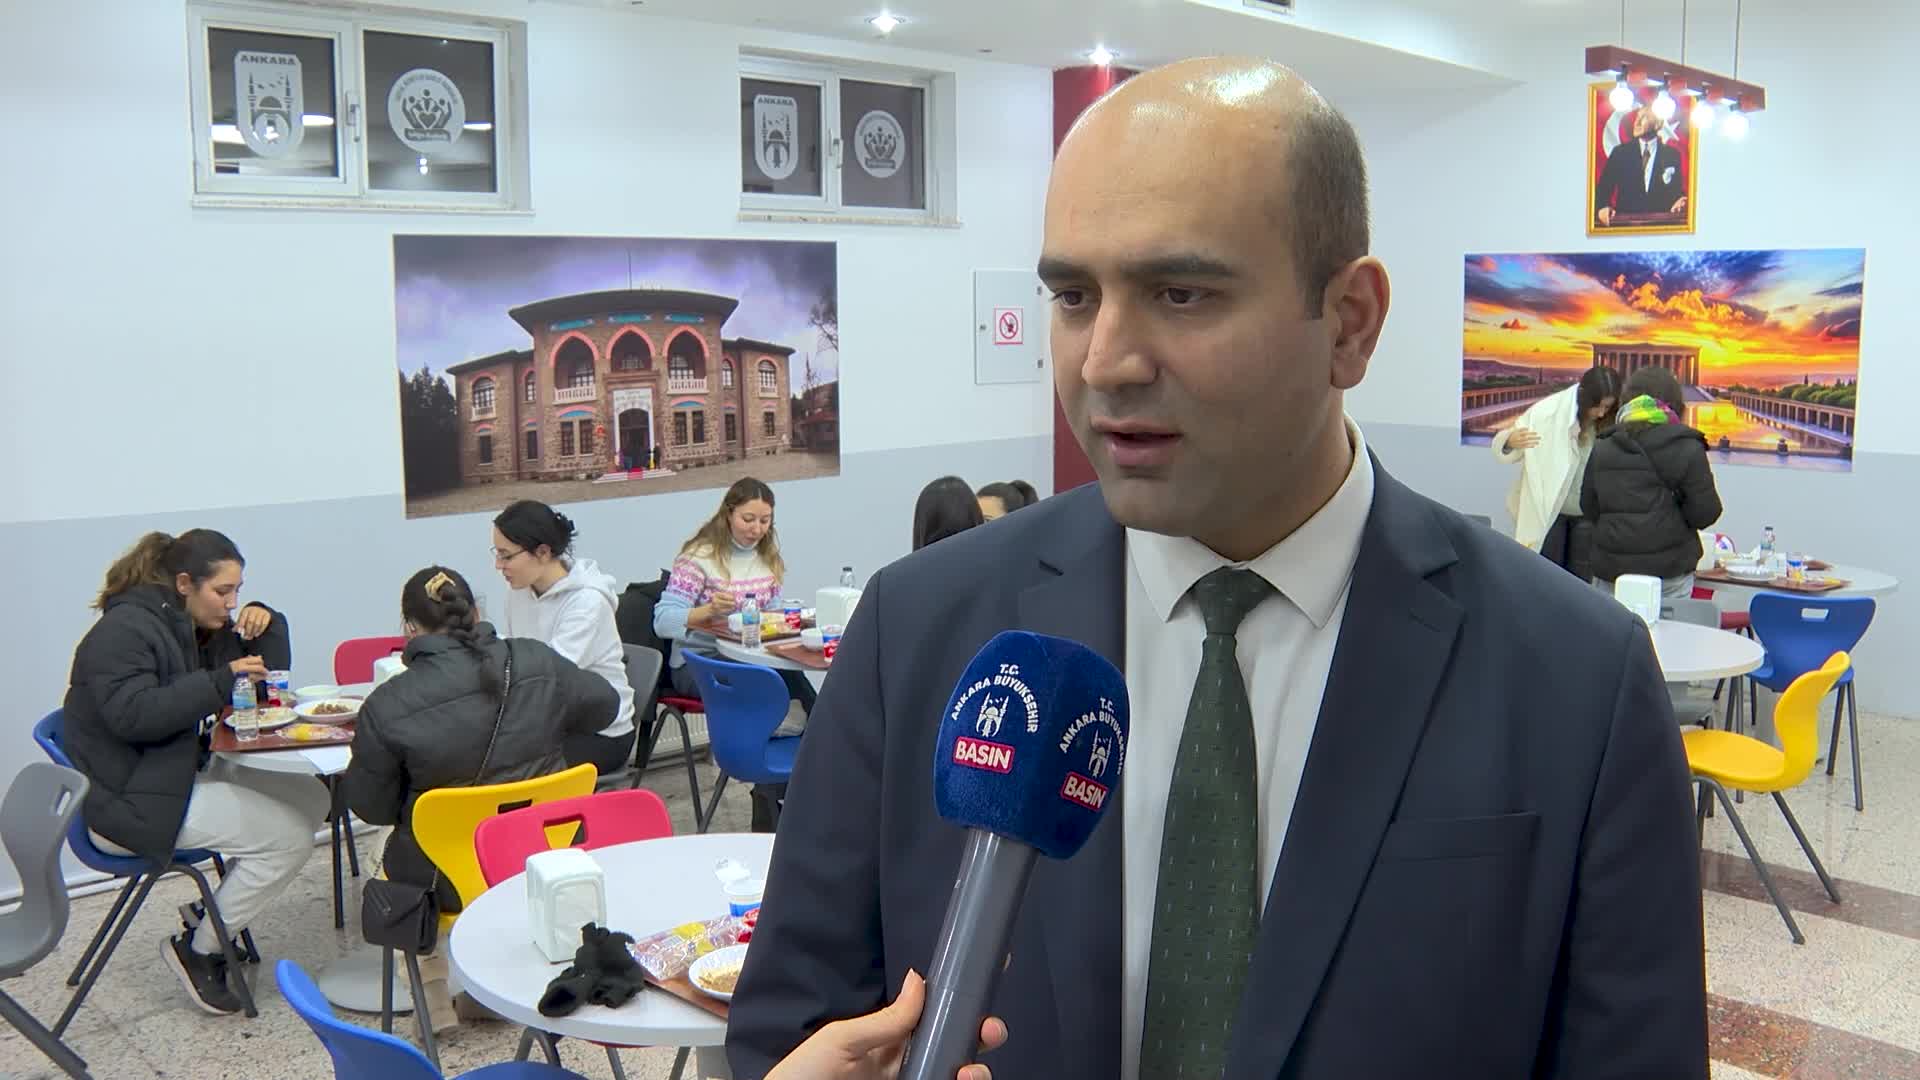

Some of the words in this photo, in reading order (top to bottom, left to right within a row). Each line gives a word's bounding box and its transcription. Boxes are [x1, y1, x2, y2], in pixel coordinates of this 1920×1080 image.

[240, 54, 297, 66] ANKARA
[1000, 664, 1019, 675] T.C.
[951, 677, 991, 720] ANKARA
[1059, 711, 1098, 754] ANKARA
[955, 740, 1011, 769] BASIN
[1063, 776, 1107, 808] BASIN
